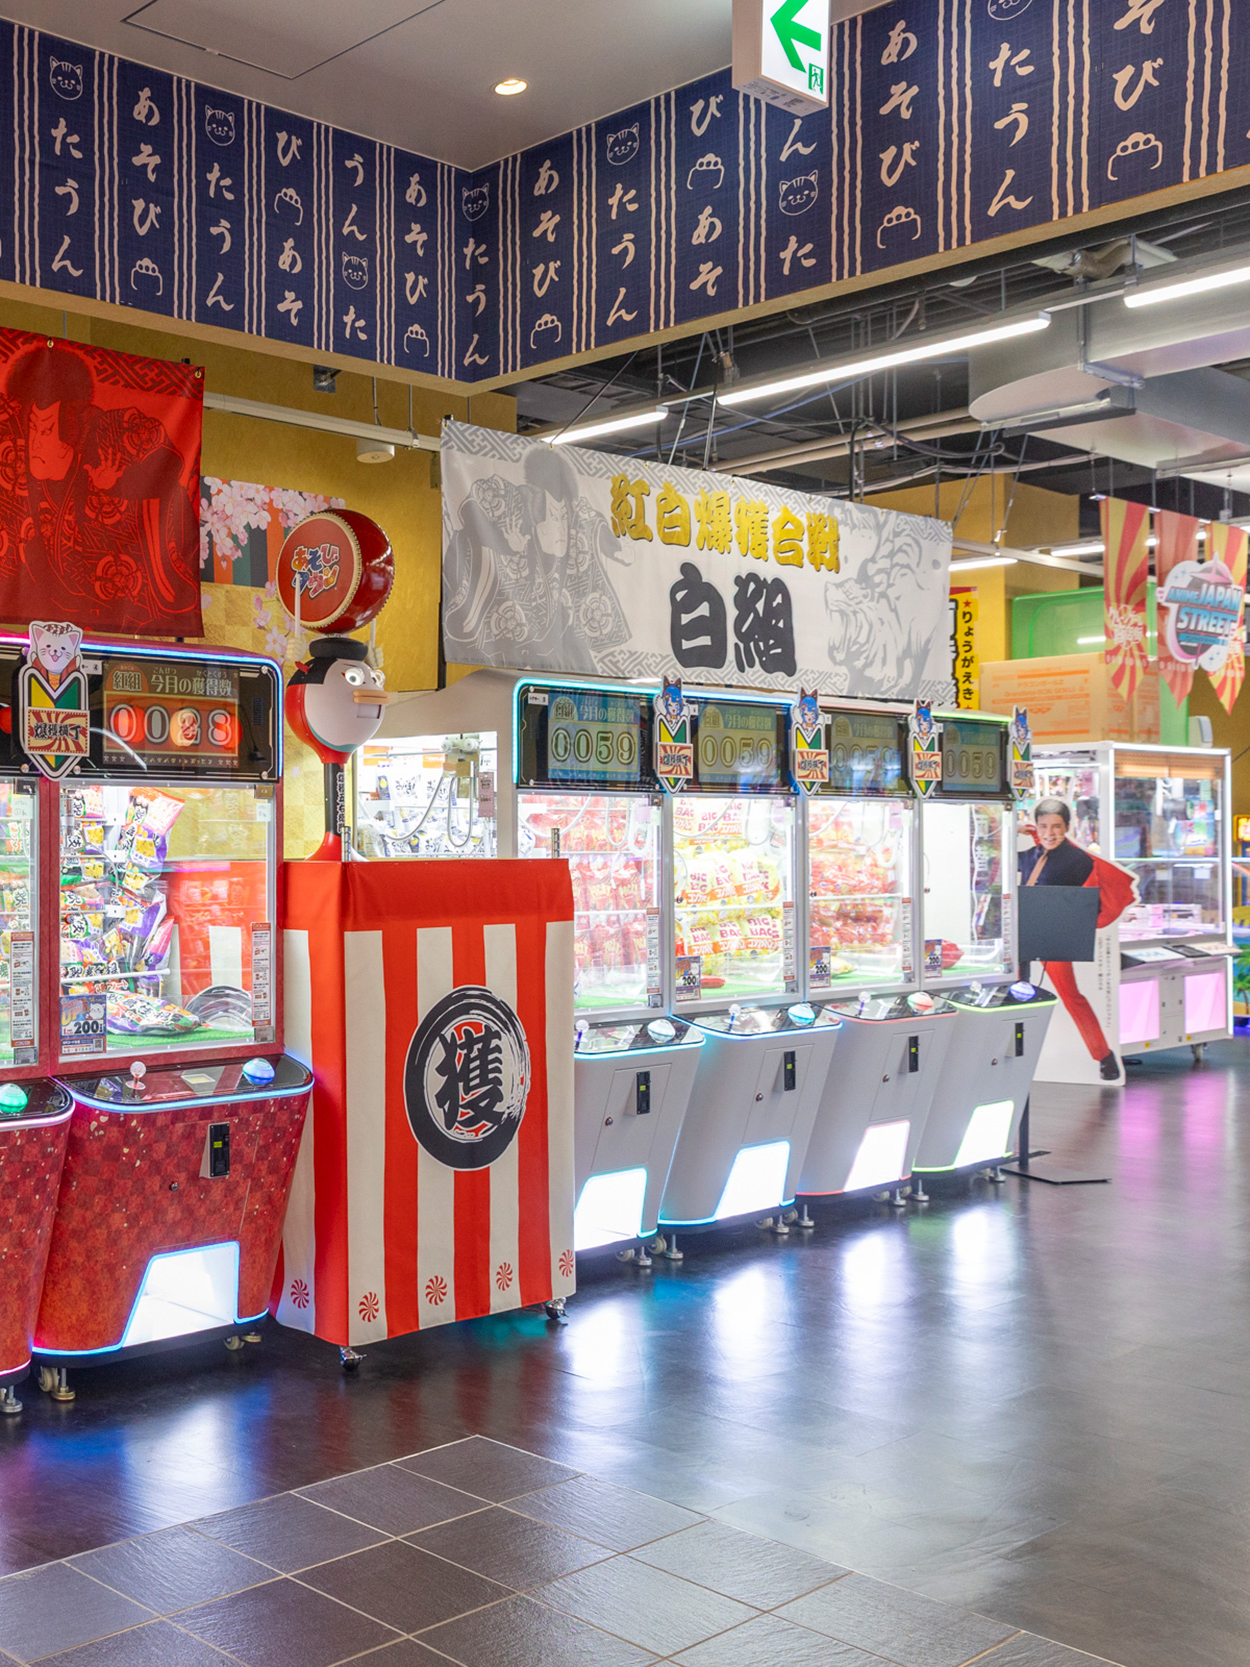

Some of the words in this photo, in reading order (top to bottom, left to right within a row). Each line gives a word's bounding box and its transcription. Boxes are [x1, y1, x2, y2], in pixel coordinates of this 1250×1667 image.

[879, 19, 920, 188] あそび
[988, 42, 1036, 217] たうん
[132, 87, 162, 236] あそび
[51, 117, 84, 277] たうん
[532, 159, 562, 298] あそび
[206, 162, 235, 311] たうん
[404, 173, 429, 306] あそび
[607, 183, 640, 327] たうん
[463, 238, 490, 367] たうん
[609, 472, 842, 575] 紅白爆獲合戦
[668, 560, 798, 678] 白組
[1165, 587, 1200, 603] ANIME
[1196, 582, 1243, 613] JAPAN
[1176, 606, 1239, 638] STREET
[111, 669, 143, 693] 紅組
[150, 673, 233, 698] 今月の獲得数
[960, 610, 975, 702] りょうがえき
[33, 721, 83, 742] 爆獲横丁
[108, 702, 233, 747] 0028
[550, 726, 637, 766] 0059
[700, 733, 775, 769] 0059
[943, 749, 998, 780] 0059
[682, 975, 697, 987] 200
[814, 963, 830, 975] 200
[928, 955, 940, 967] 200
[73, 1020, 100, 1035] 200
[434, 1023, 505, 1132] 獲
